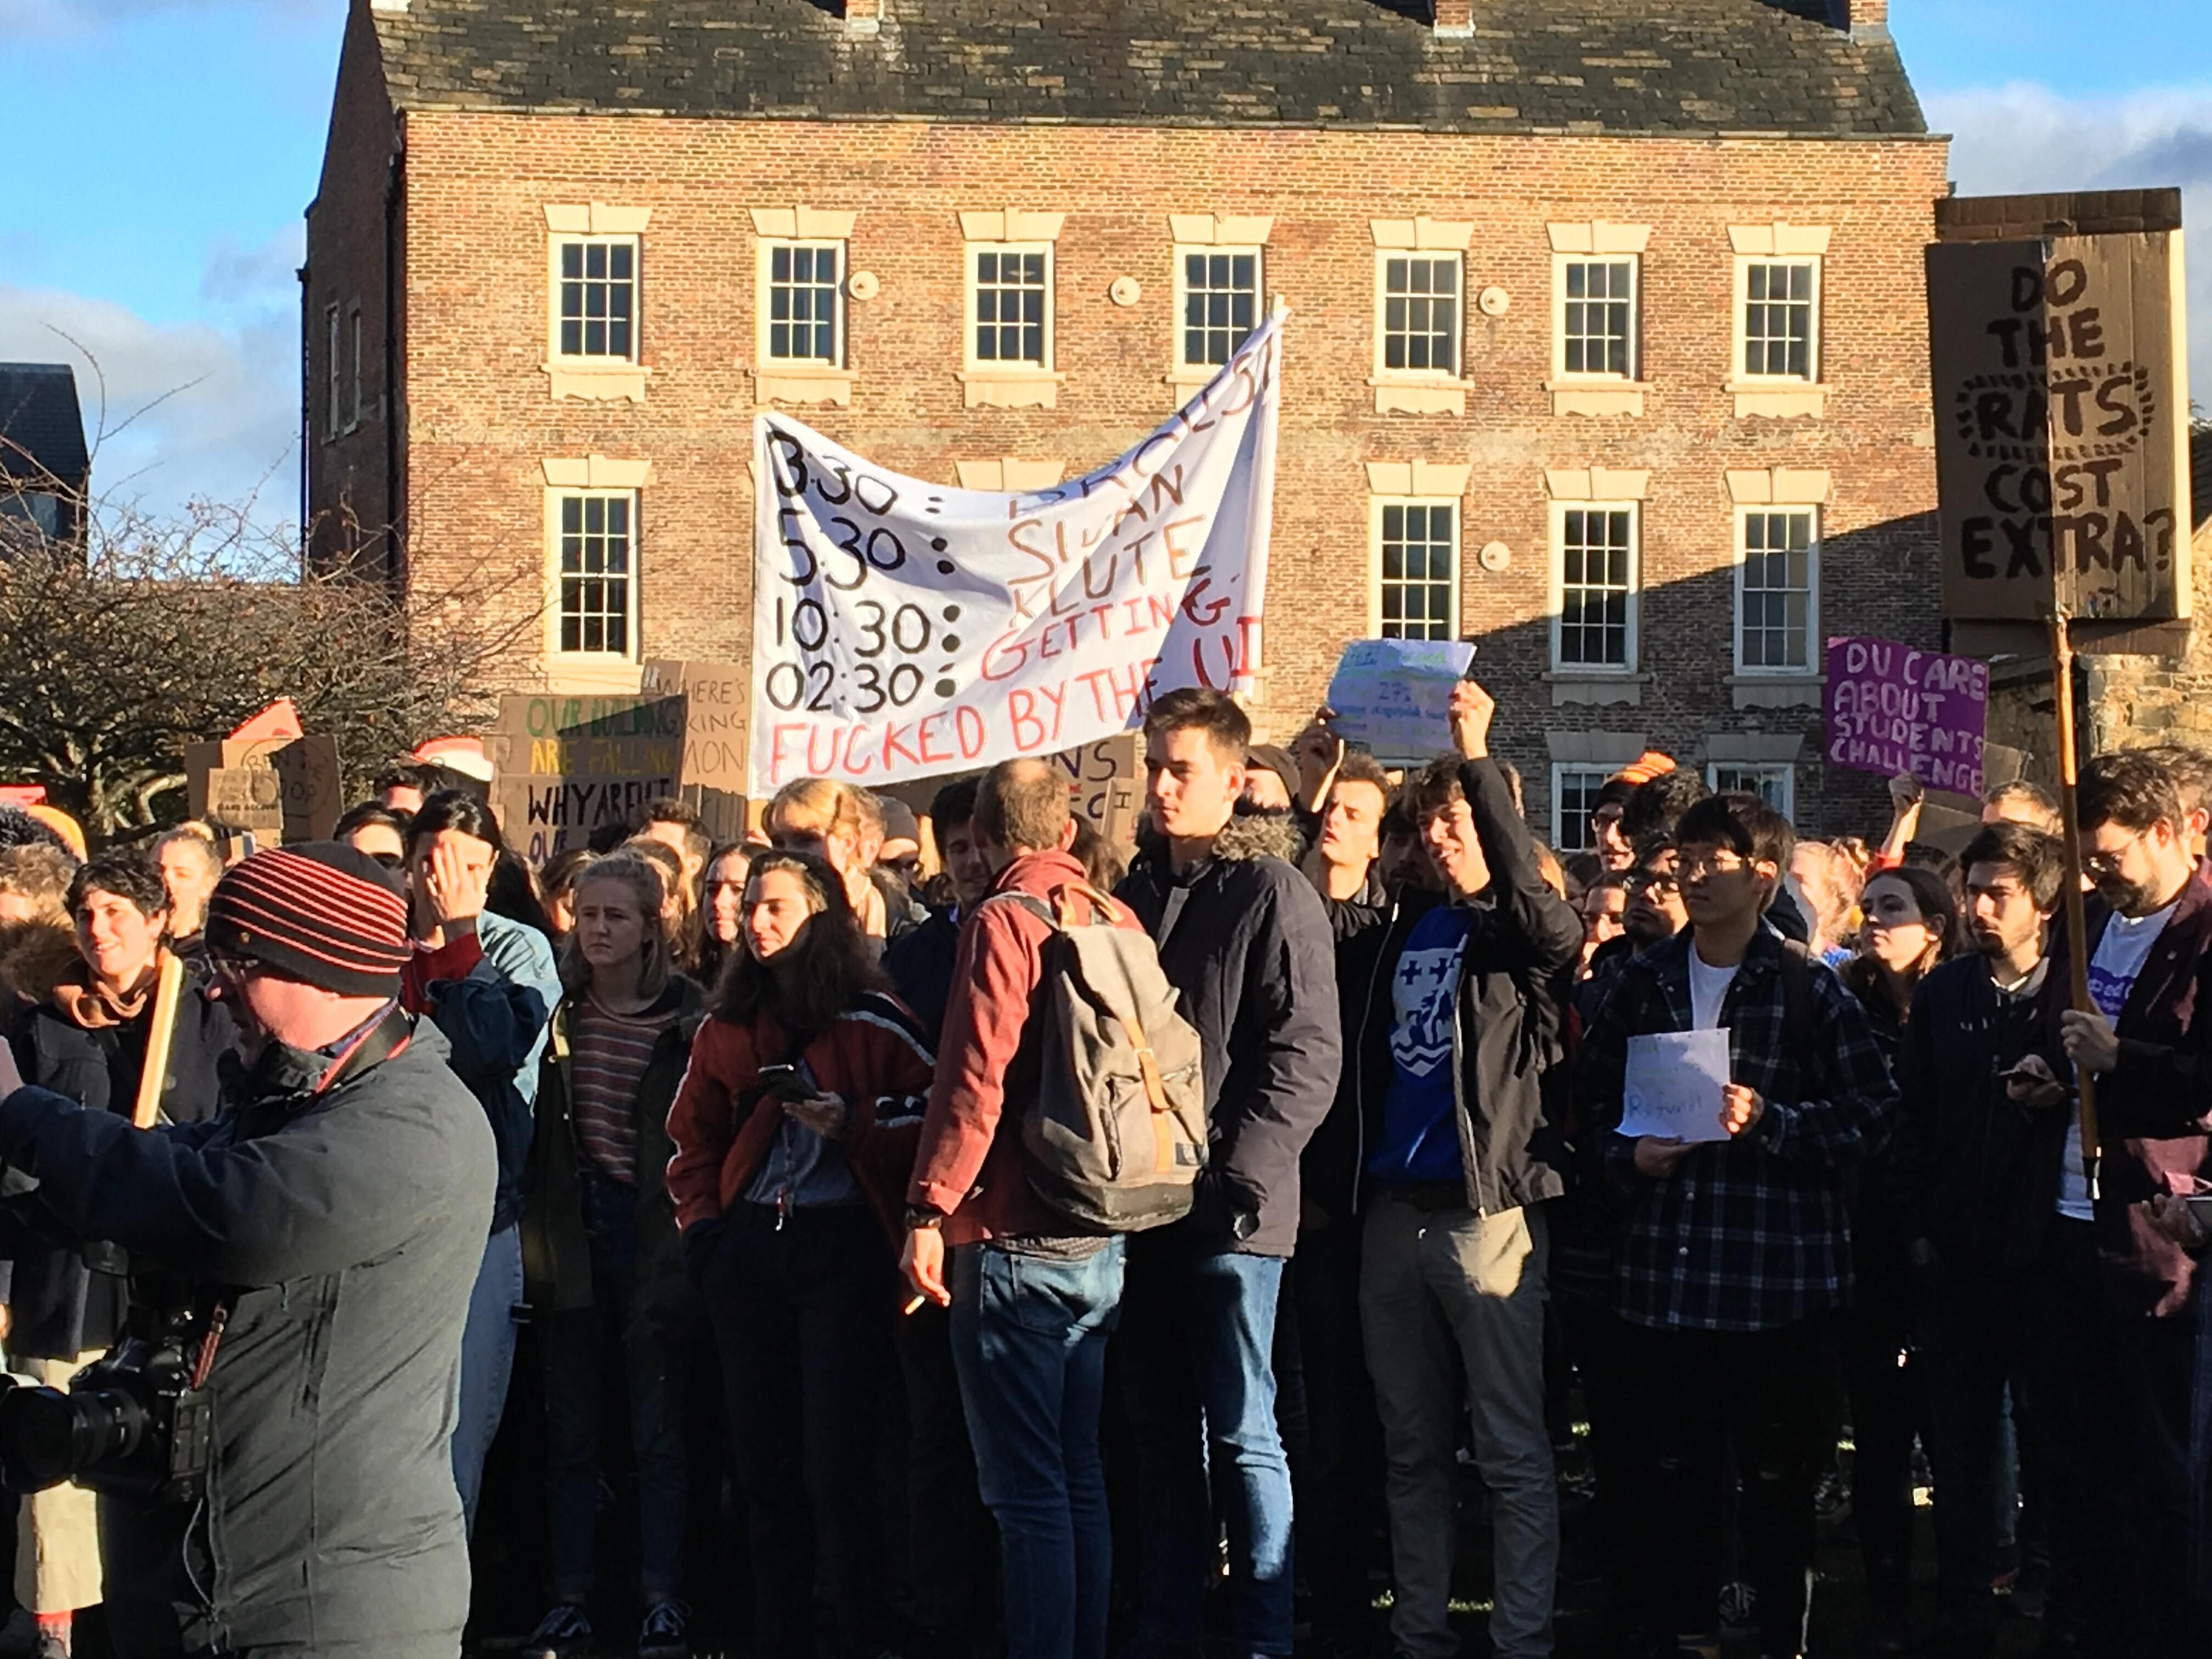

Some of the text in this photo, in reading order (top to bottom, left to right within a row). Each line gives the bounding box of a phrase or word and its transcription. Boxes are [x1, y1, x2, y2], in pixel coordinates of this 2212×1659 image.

[2011, 258, 2087, 313] DO
[1988, 307, 2105, 369] THE
[1975, 375, 2138, 441] RATS
[1984, 458, 2123, 513] COST
[1010, 515, 1211, 627] KLUTE
[1961, 507, 2176, 580] EXTRA?
[981, 577, 1232, 681] GETTING
[1847, 642, 1986, 701] DU CARE
[526, 698, 582, 737] OUR
[770, 706, 985, 785] FUCKED
[1009, 680, 1067, 751] BY
[1075, 656, 1164, 723] THE
[1834, 680, 1945, 723] ABOUT
[530, 739, 578, 774] ARE
[1833, 712, 1983, 760] STUDENTS
[1830, 738, 1983, 795] CHALLENGE
[528, 783, 595, 825] WHY
